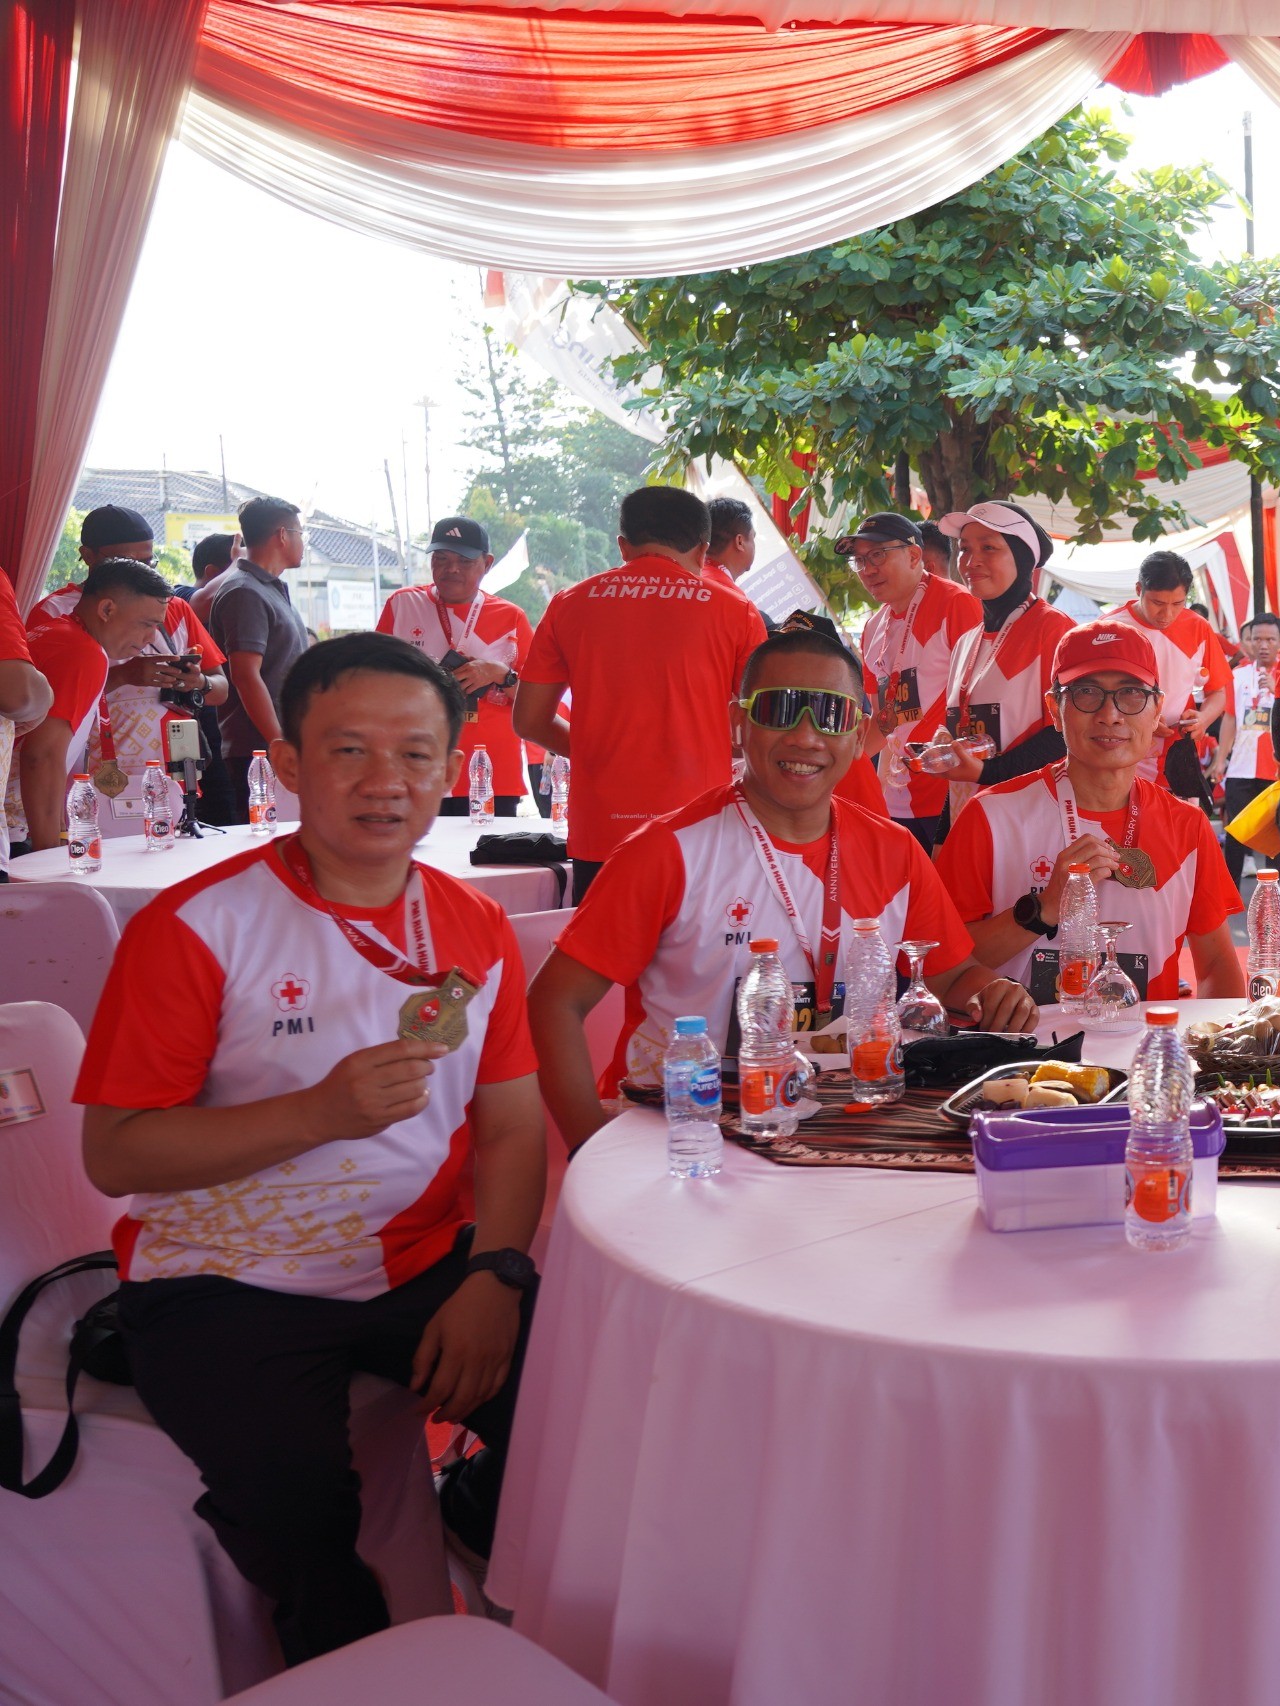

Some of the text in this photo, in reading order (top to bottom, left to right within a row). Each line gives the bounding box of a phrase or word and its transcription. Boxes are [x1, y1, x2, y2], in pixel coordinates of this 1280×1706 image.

[600, 575, 704, 588] KAWAN LARI
[588, 585, 712, 602] LAMPUNG
[1096, 633, 1118, 641] NIKE
[903, 709, 919, 722] VIP
[1066, 799, 1074, 818] PMI
[154, 824, 169, 834] Cleo
[1068, 818, 1078, 835] RUN
[1122, 815, 1138, 850] ERSARY
[70, 843, 85, 855] Cleo
[752, 825, 765, 841] PMI
[761, 843, 775, 863] RUN
[772, 870, 797, 918] HUMANITY
[829, 831, 838, 902] ANNIVERSA
[411, 900, 420, 921] PMI
[411, 921, 425, 943] RUN
[1252, 982, 1272, 997] Cleo
[272, 1016, 315, 1038] PMI
